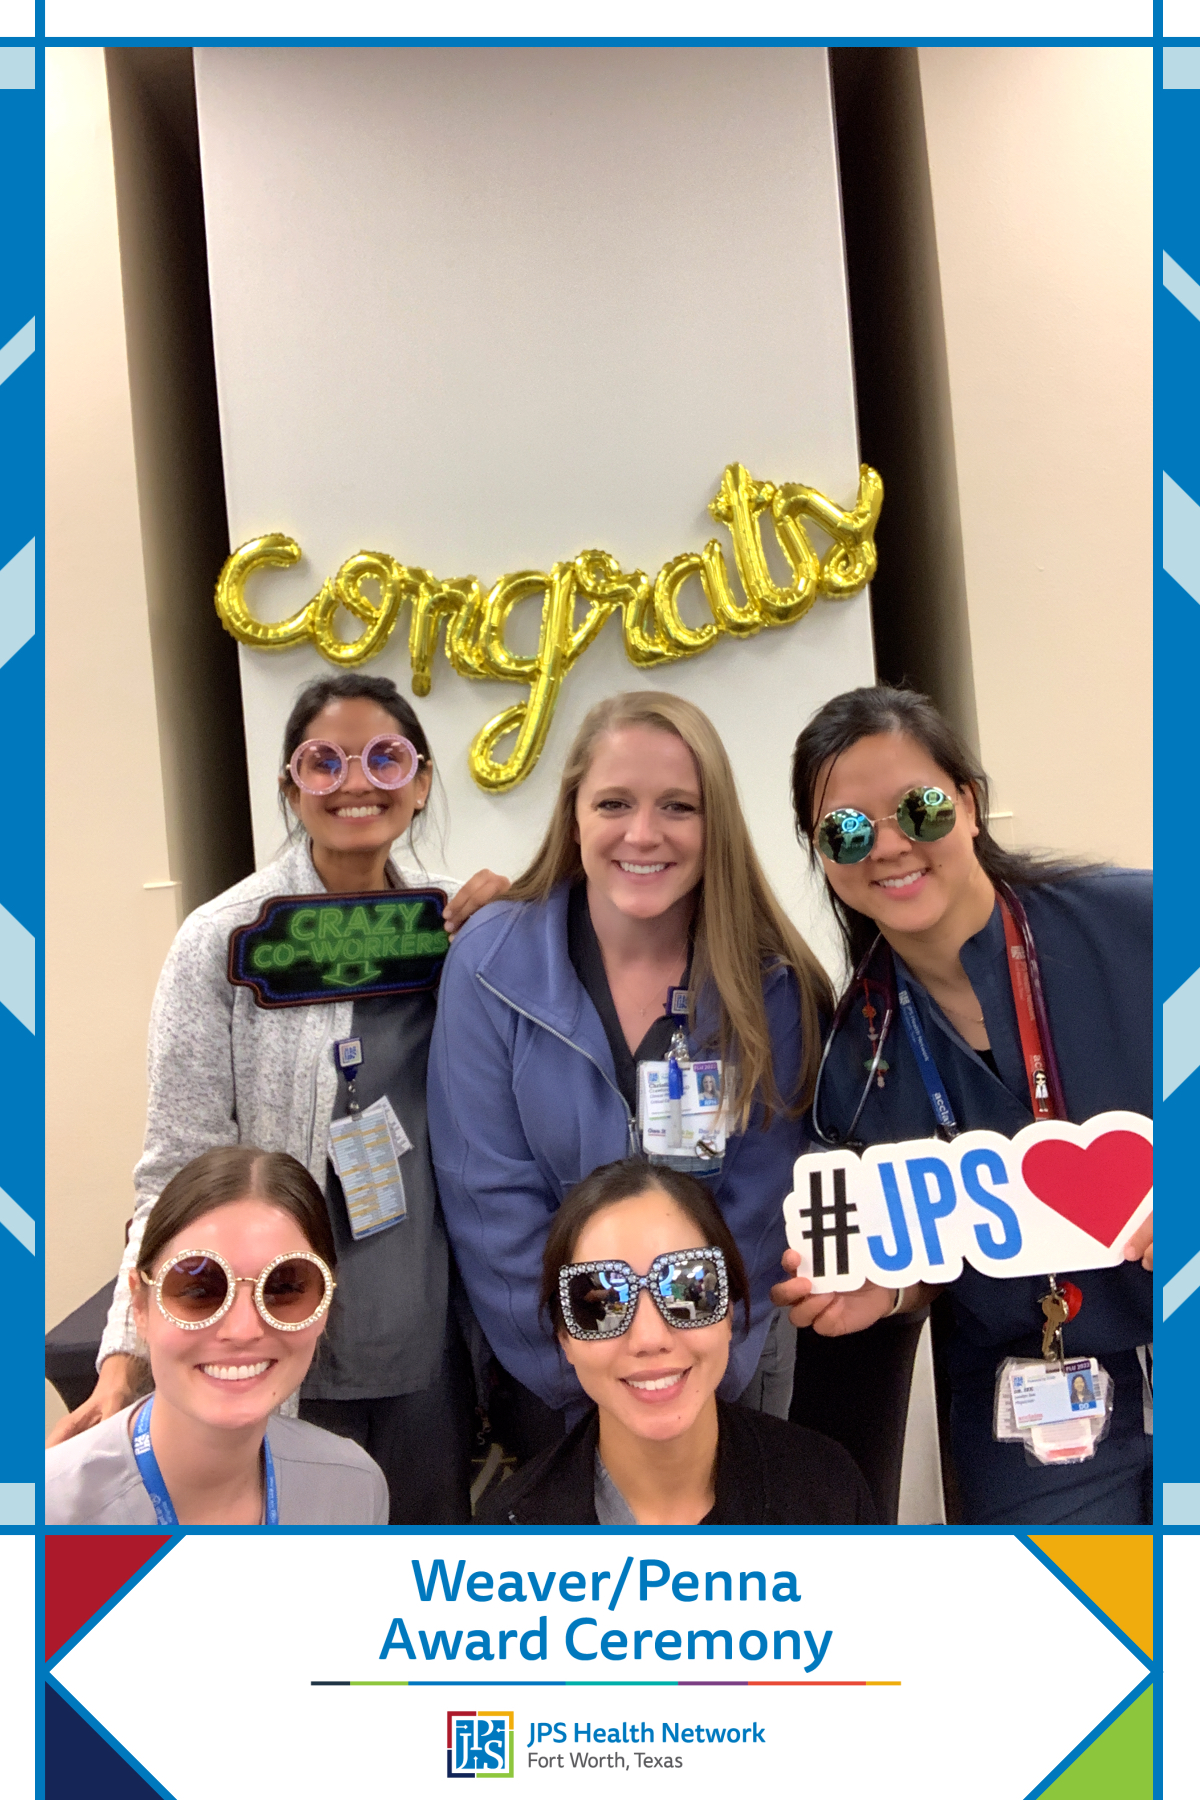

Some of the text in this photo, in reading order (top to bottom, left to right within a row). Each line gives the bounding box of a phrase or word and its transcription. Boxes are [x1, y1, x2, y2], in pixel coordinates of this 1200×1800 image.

[215, 462, 884, 794] congrats
[253, 932, 449, 968] CO-WORKERS
[291, 903, 424, 941] CRAZY
[799, 1148, 1023, 1278] #JPS
